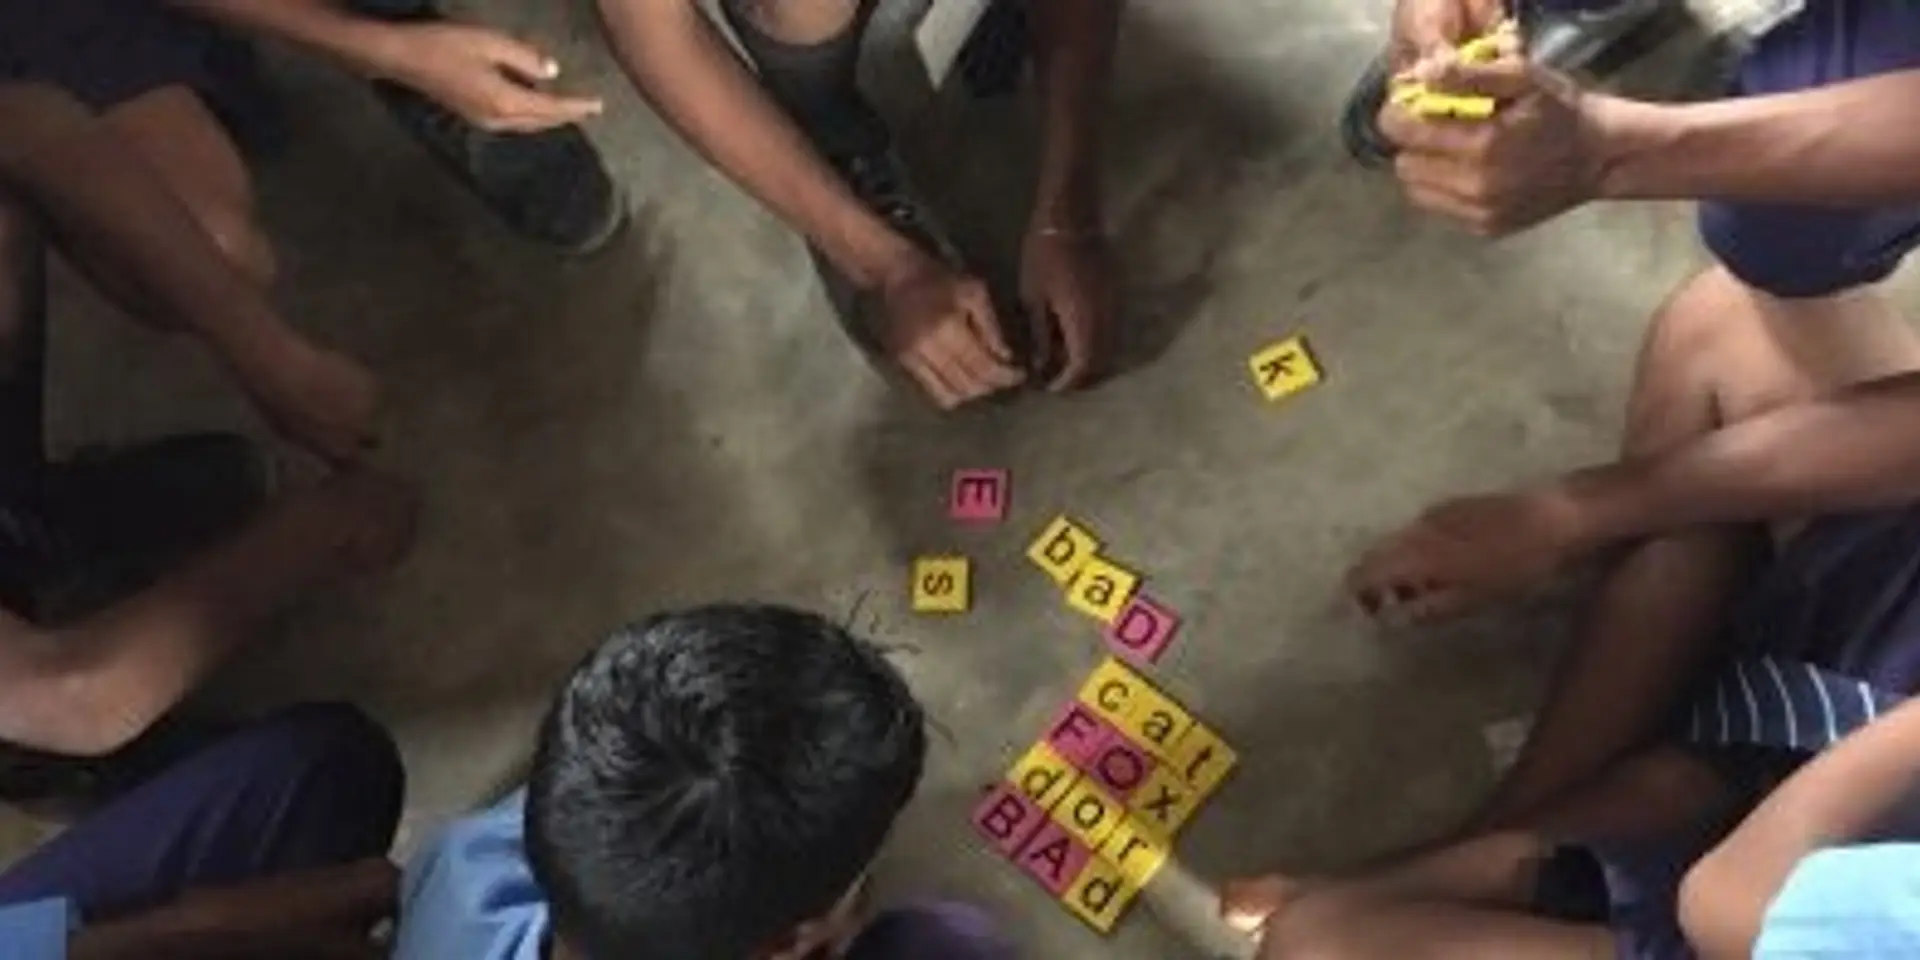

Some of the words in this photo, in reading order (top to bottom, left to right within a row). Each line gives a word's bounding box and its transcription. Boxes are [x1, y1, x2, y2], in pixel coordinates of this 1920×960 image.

[957, 476, 999, 508] E
[1096, 679, 1214, 786] cat
[980, 793, 1125, 916] BAd
[1020, 764, 1149, 863] dor
